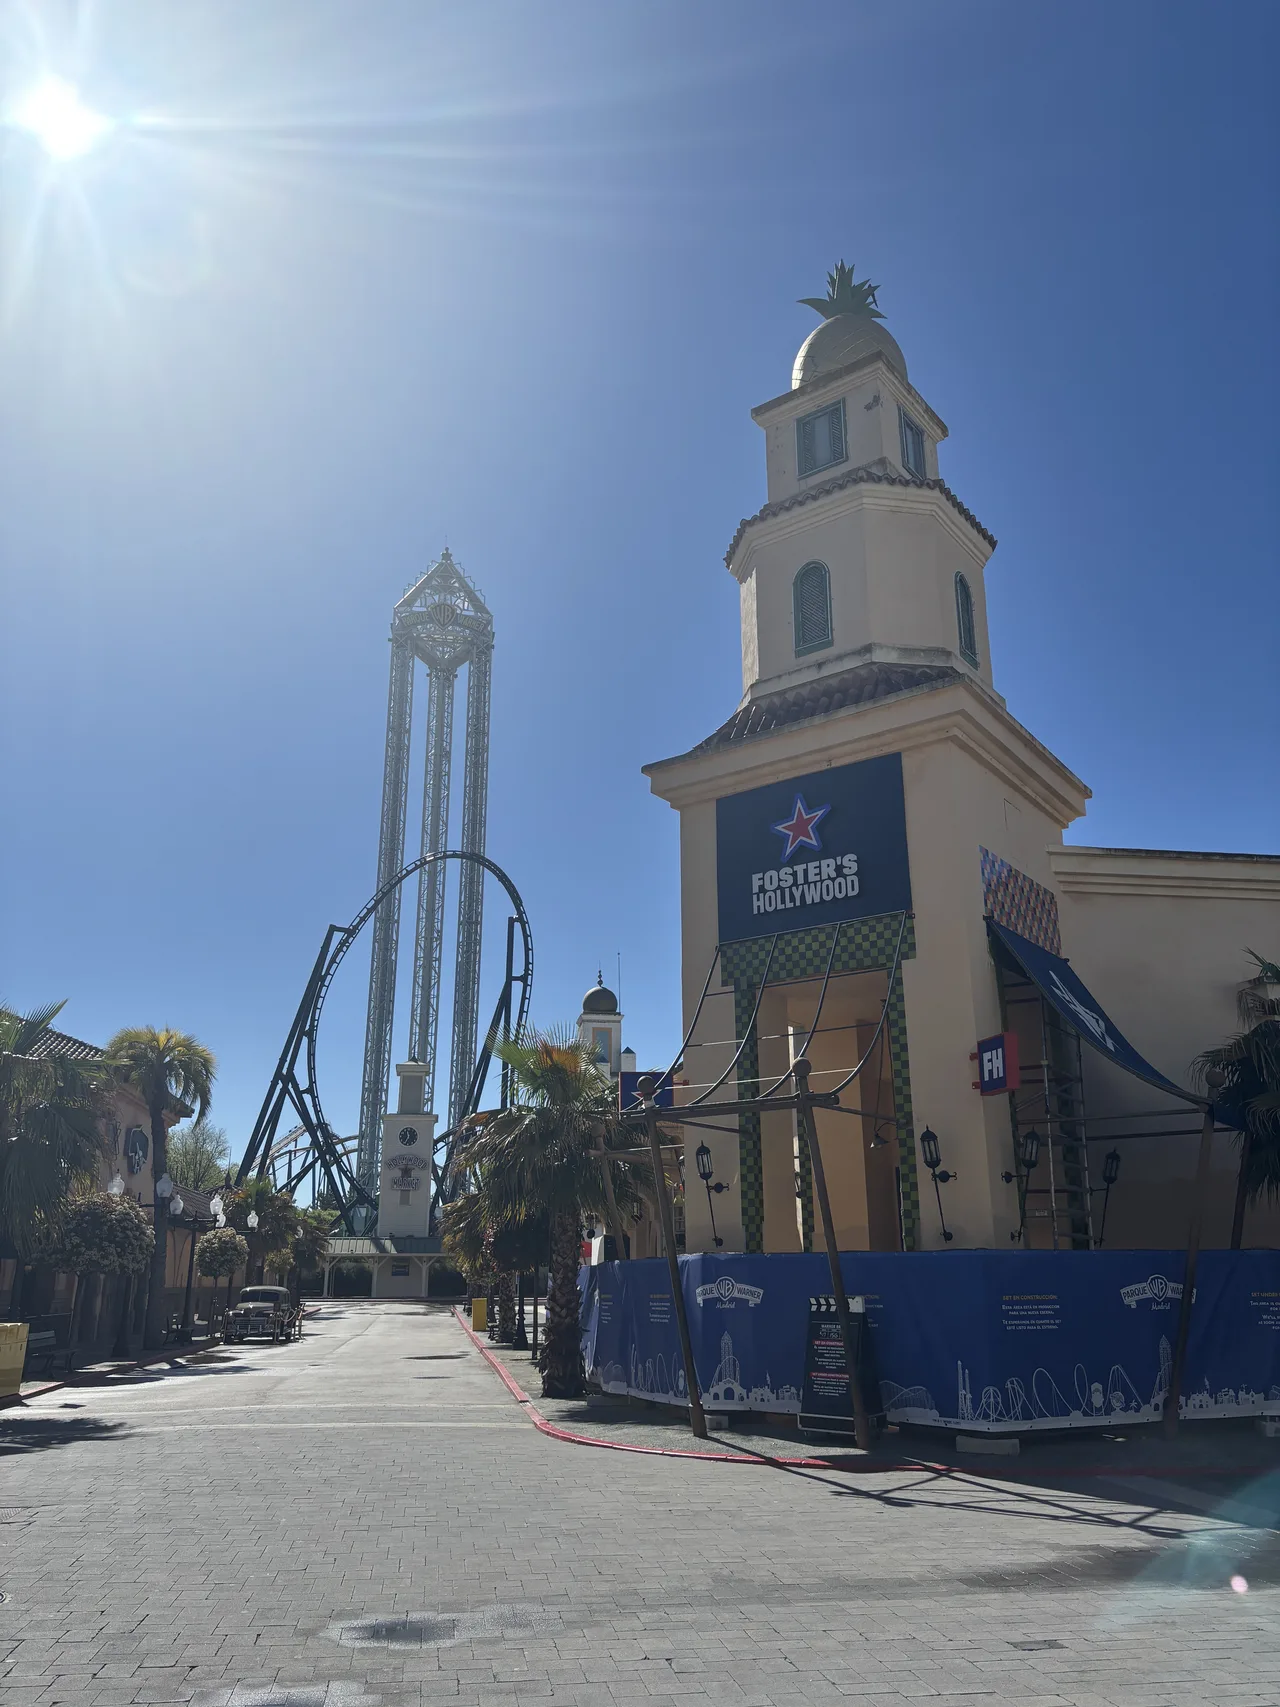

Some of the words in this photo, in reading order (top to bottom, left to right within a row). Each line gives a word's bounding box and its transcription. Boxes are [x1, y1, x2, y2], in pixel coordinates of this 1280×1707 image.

[402, 612, 430, 626] PARQUE
[457, 613, 486, 633] WARNER
[751, 853, 858, 894] FOSTER'S
[752, 874, 860, 915] HOLLYWOOD
[982, 1047, 1004, 1082] FH
[386, 1154, 428, 1170] HOLLYWOOD
[392, 1177, 420, 1190] MARKET
[736, 1285, 763, 1300] WARNER
[1121, 1285, 1149, 1301] PARQUE
